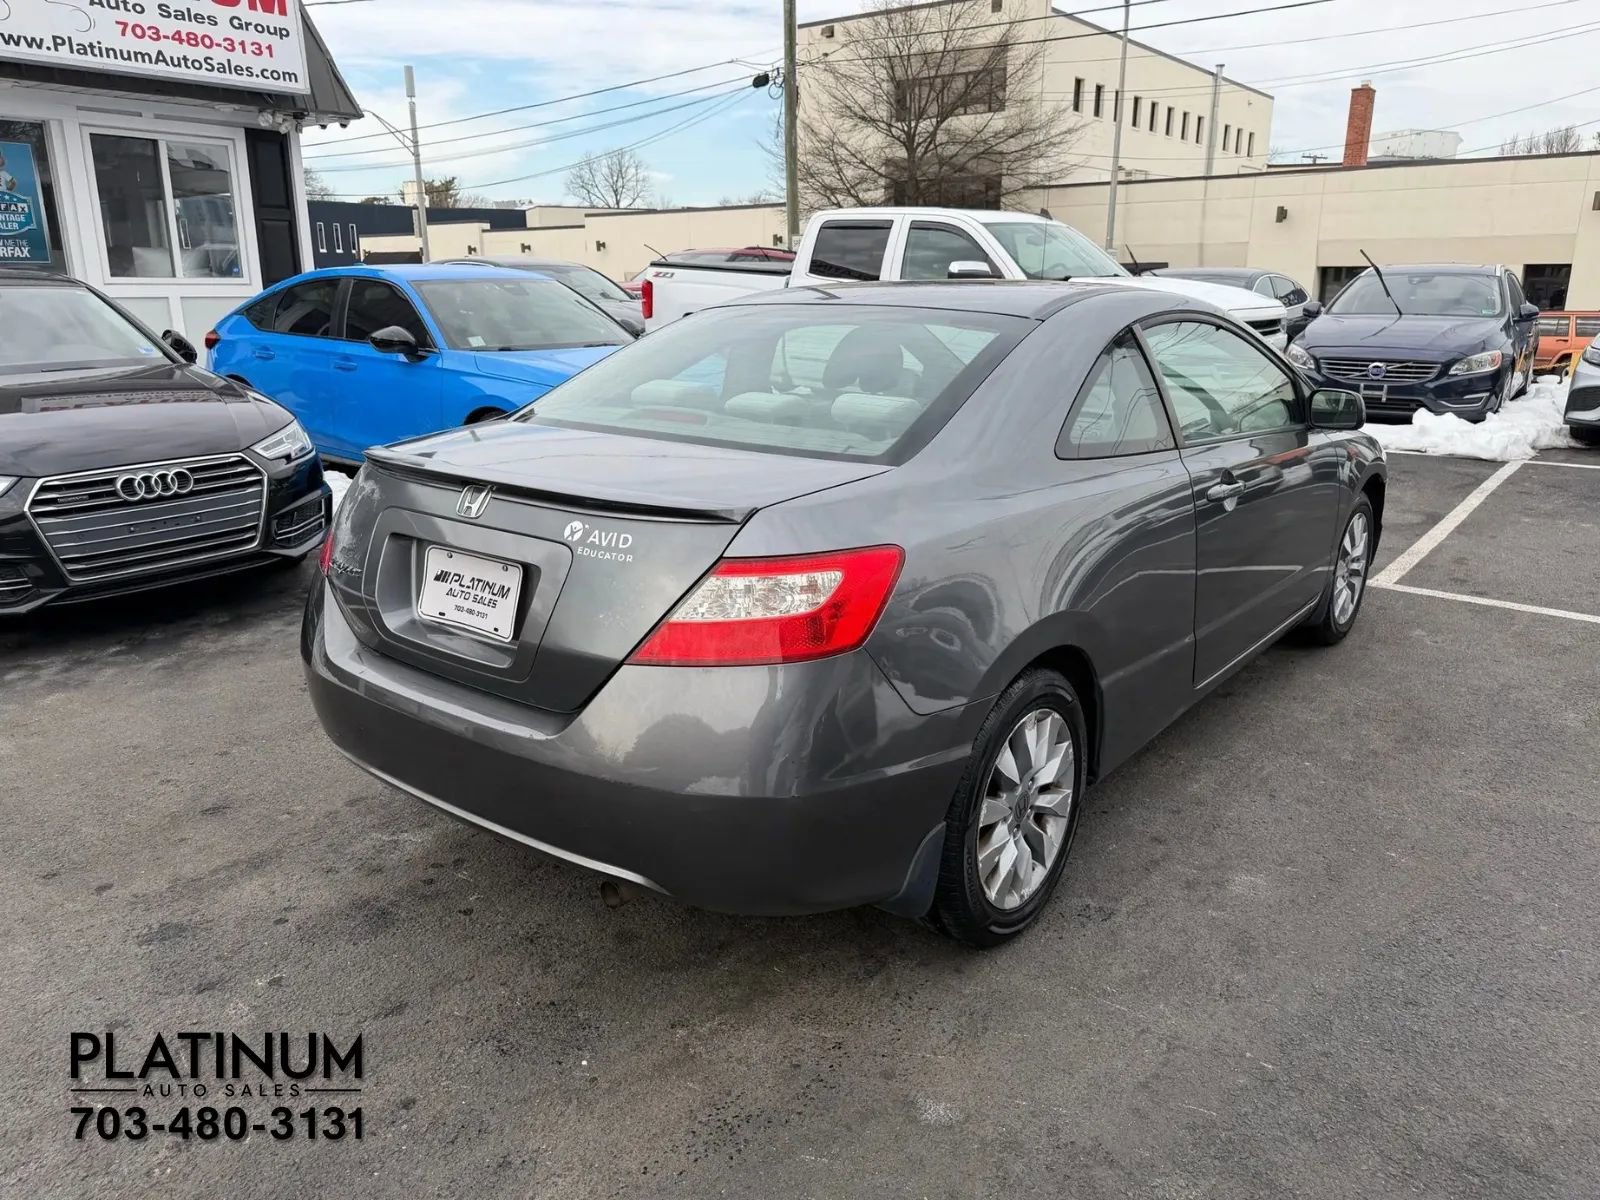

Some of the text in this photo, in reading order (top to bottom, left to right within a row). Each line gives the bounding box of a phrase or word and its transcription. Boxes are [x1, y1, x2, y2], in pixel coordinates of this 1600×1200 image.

[157, 3, 219, 27] Sales
[229, 15, 290, 40] Group
[115, 20, 274, 58] 703-480-3131
[586, 529, 633, 549] AVID
[577, 546, 633, 562] EDUCATOR
[449, 572, 511, 600] PLATINUM
[446, 587, 498, 609] AUTO SALES
[454, 604, 489, 620] 703-480-3131
